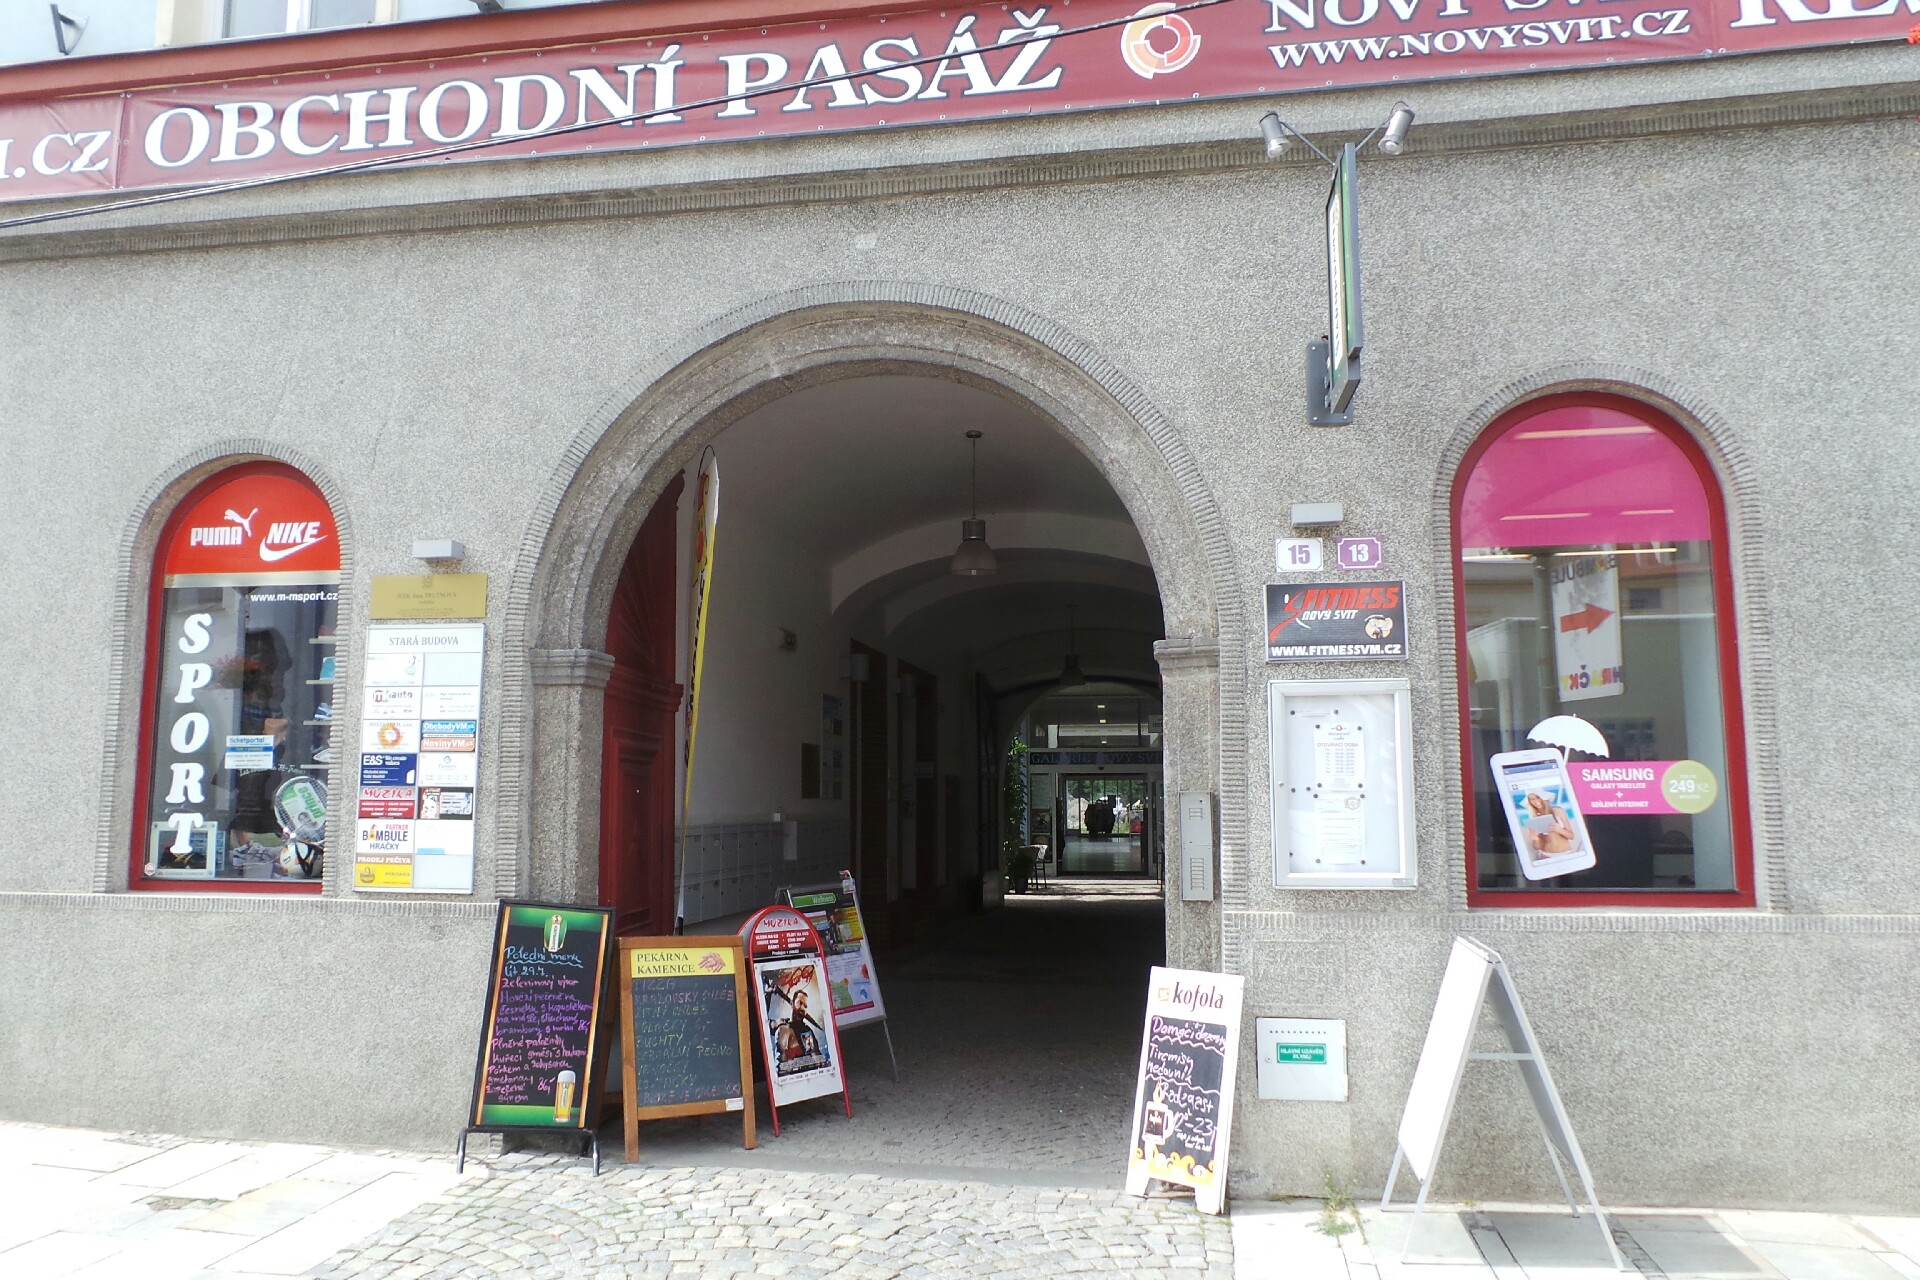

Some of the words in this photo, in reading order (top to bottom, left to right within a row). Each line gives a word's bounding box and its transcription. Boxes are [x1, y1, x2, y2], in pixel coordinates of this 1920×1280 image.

[1267, 9, 1691, 68] WWW.NOVYSVIT.CZ
[143, 45, 685, 168] OBCHODNÍ
[717, 7, 1065, 118] PASÁŽ
[190, 526, 243, 546] PUMA
[265, 521, 321, 544] NIKE
[1287, 544, 1311, 565] 15
[1348, 543, 1370, 563] 13
[250, 592, 338, 603] www.m-msport.cz
[1302, 587, 1399, 611] FITNESS
[389, 635, 419, 646] STARÁ
[421, 636, 459, 646] BUDOVA
[1271, 644, 1401, 657] WWW.FITNESSVM.CZ
[165, 613, 214, 854] SPORT
[363, 755, 383, 766] E&S
[1031, 753, 1091, 763] GALRIE
[1581, 768, 1654, 782] SAMSUNG
[1669, 780, 1695, 793] 249
[363, 788, 413, 799] MUZIKA
[369, 842, 400, 851] HRAČKY
[763, 917, 799, 928] MUZIKA
[637, 951, 689, 963] PEKÁRNA
[637, 963, 696, 975] KAMENICE
[1172, 981, 1224, 1012] kofola
